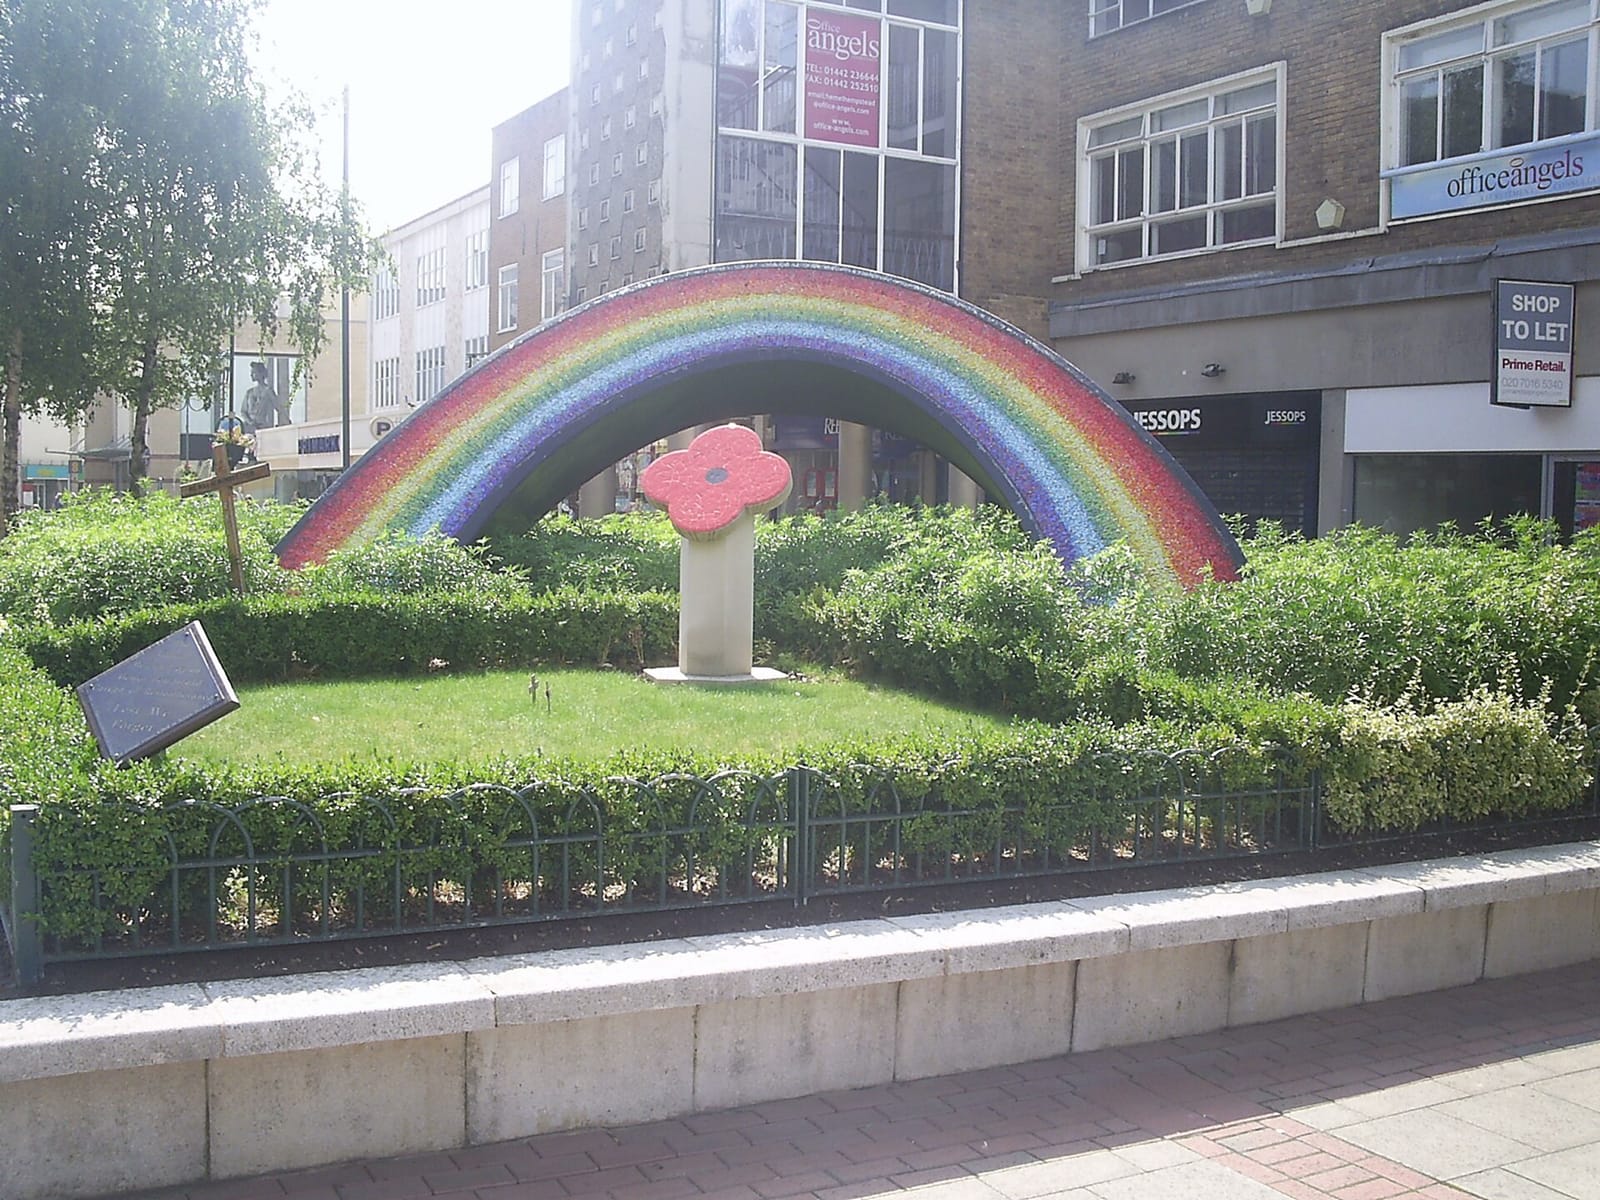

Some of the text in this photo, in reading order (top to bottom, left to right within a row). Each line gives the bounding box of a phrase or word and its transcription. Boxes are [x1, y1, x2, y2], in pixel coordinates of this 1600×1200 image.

[808, 30, 880, 60] angels
[806, 63, 822, 73] TEL:
[824, 66, 848, 78] 01442
[824, 76, 848, 89] 01442
[850, 81, 879, 94] 252510
[1511, 294, 1560, 313] SHOP
[1502, 320, 1569, 342] TO LET
[1502, 358, 1534, 371] Prime
[1502, 377, 1520, 388] 020
[1264, 410, 1306, 425] JESSOPS
[376, 421, 391, 436] P
